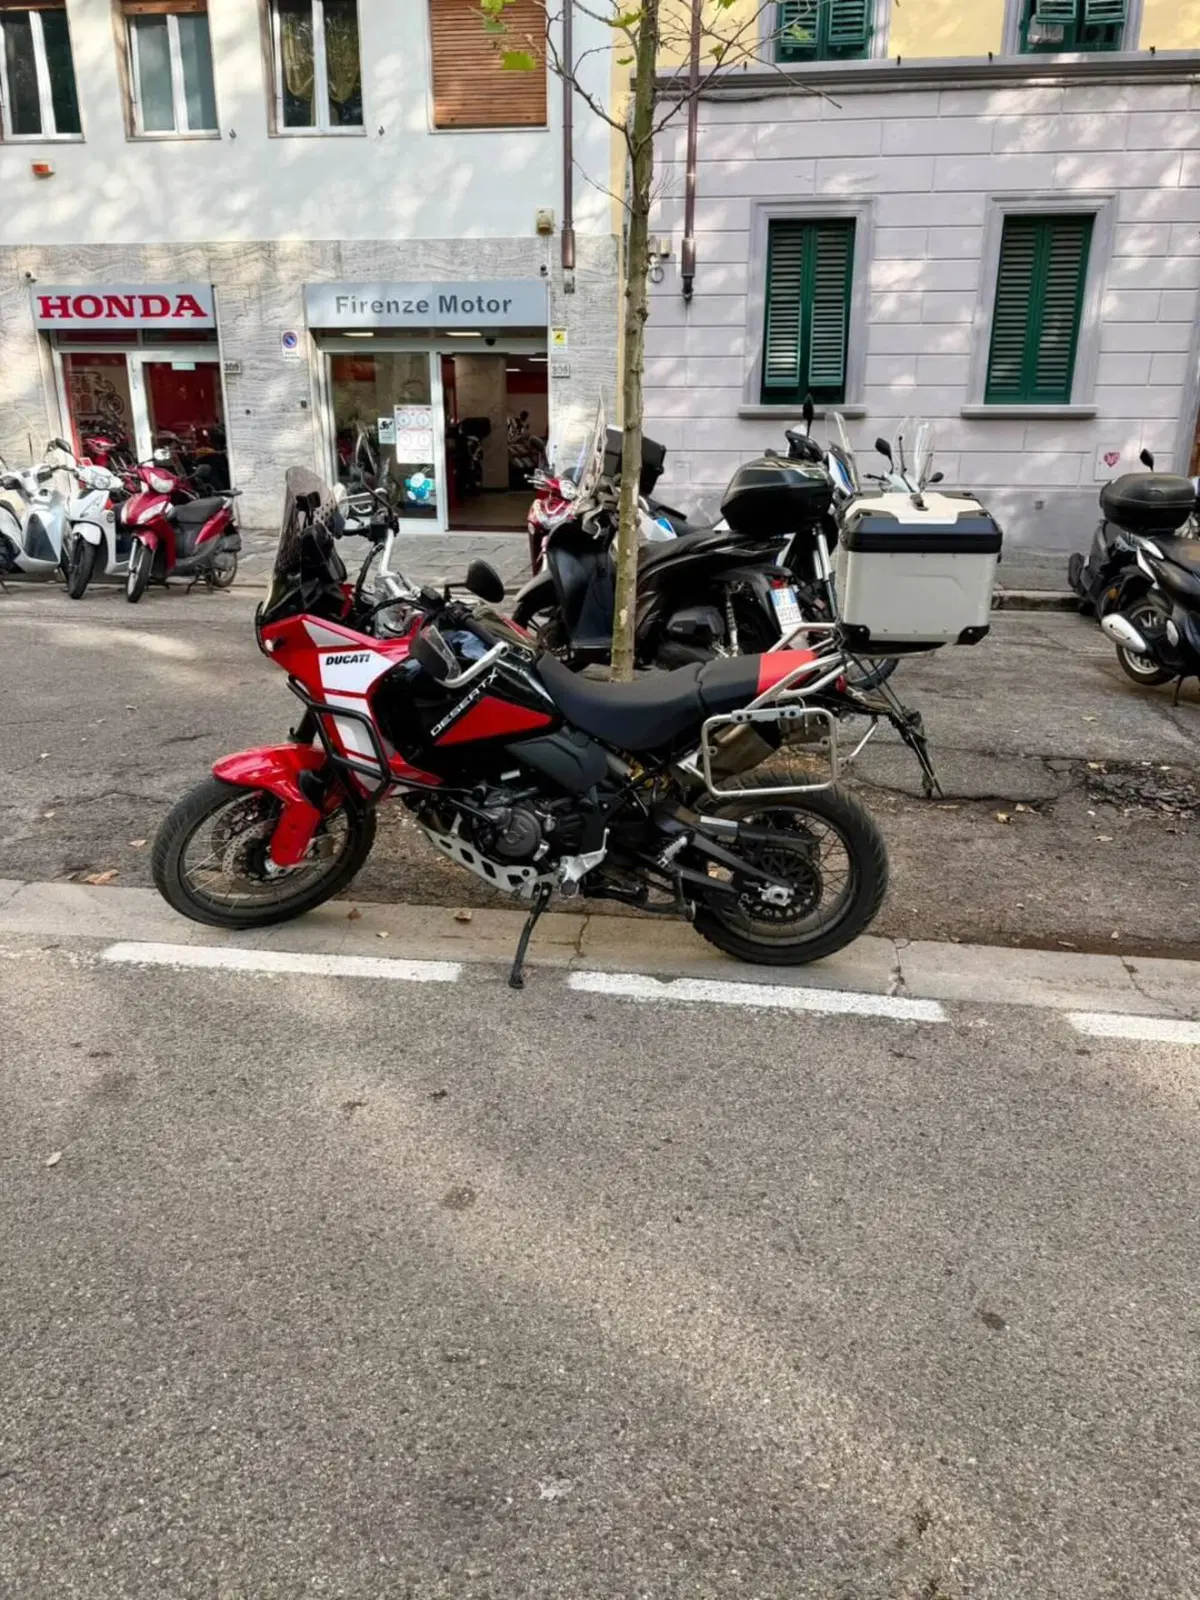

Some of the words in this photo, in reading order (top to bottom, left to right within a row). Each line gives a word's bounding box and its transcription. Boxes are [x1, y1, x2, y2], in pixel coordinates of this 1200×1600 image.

[37, 294, 208, 319] HONDA
[335, 296, 430, 314] Firenze
[438, 295, 512, 314] Motor
[326, 654, 370, 665] DUCATI
